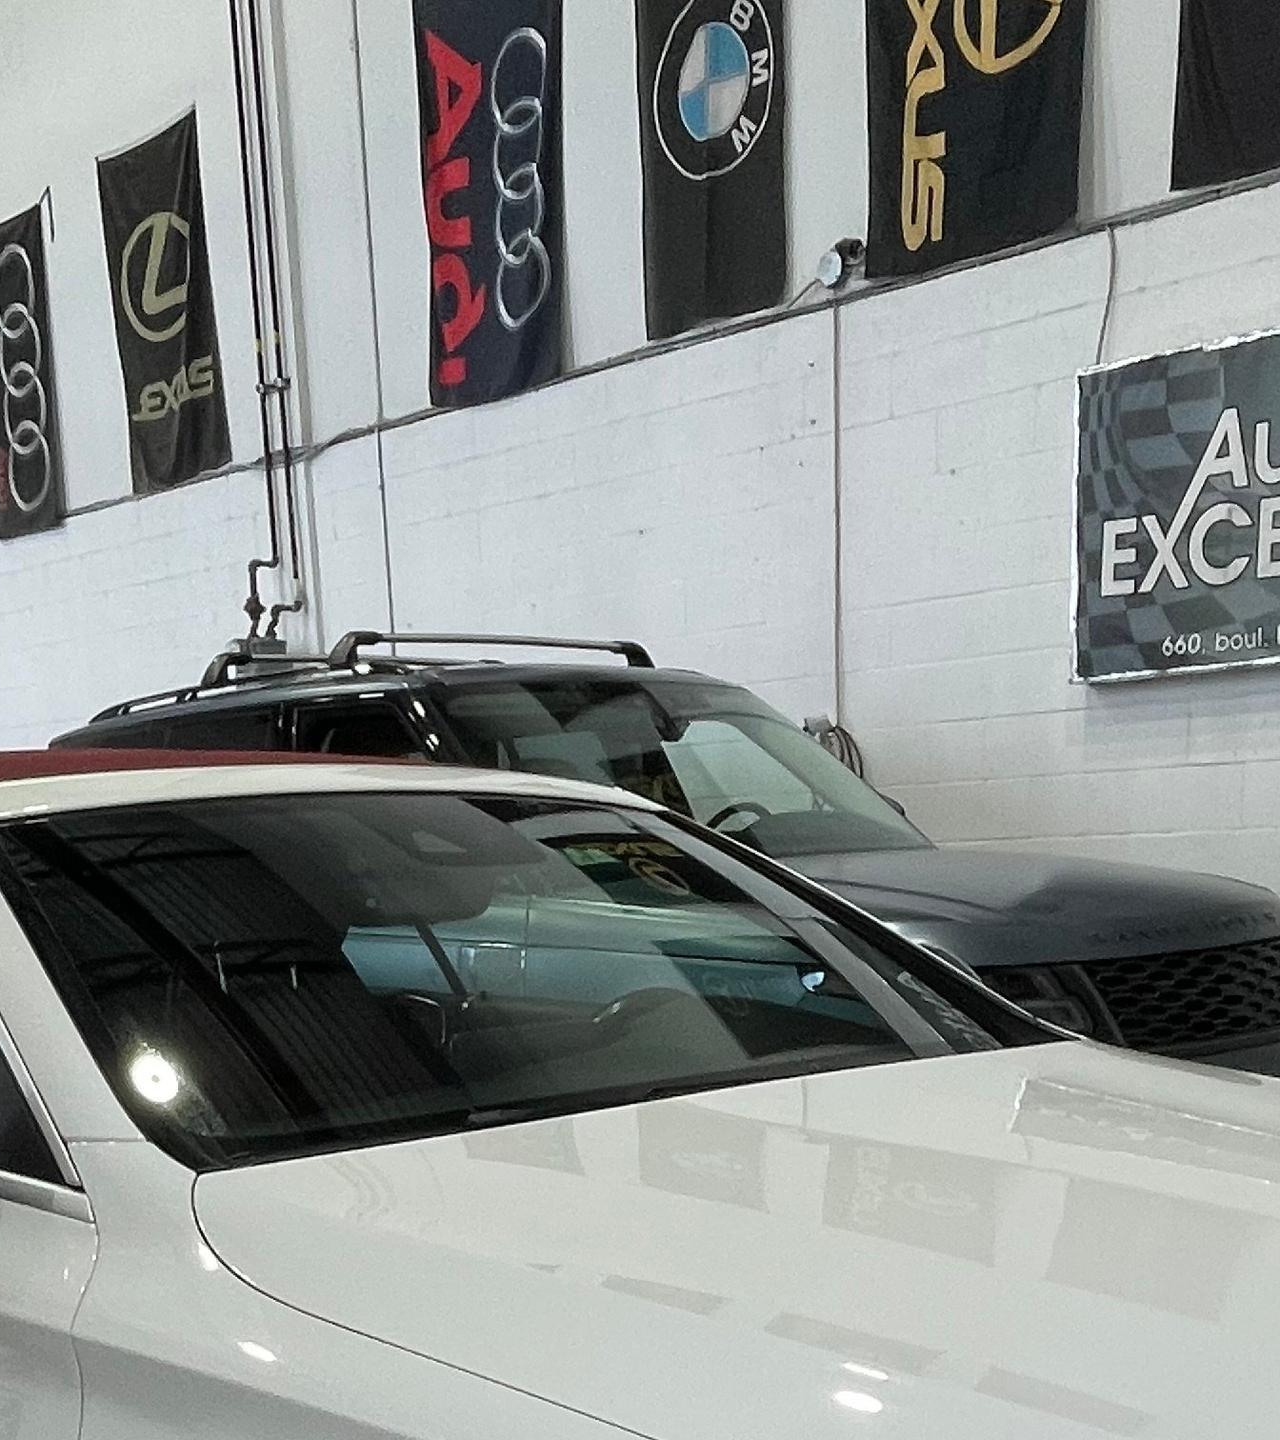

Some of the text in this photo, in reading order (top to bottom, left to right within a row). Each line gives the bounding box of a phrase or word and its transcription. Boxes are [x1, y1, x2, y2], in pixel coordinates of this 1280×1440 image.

[730, 0, 768, 152] BMW
[1161, 632, 1206, 657] 660,
[1214, 627, 1268, 652] boul.
